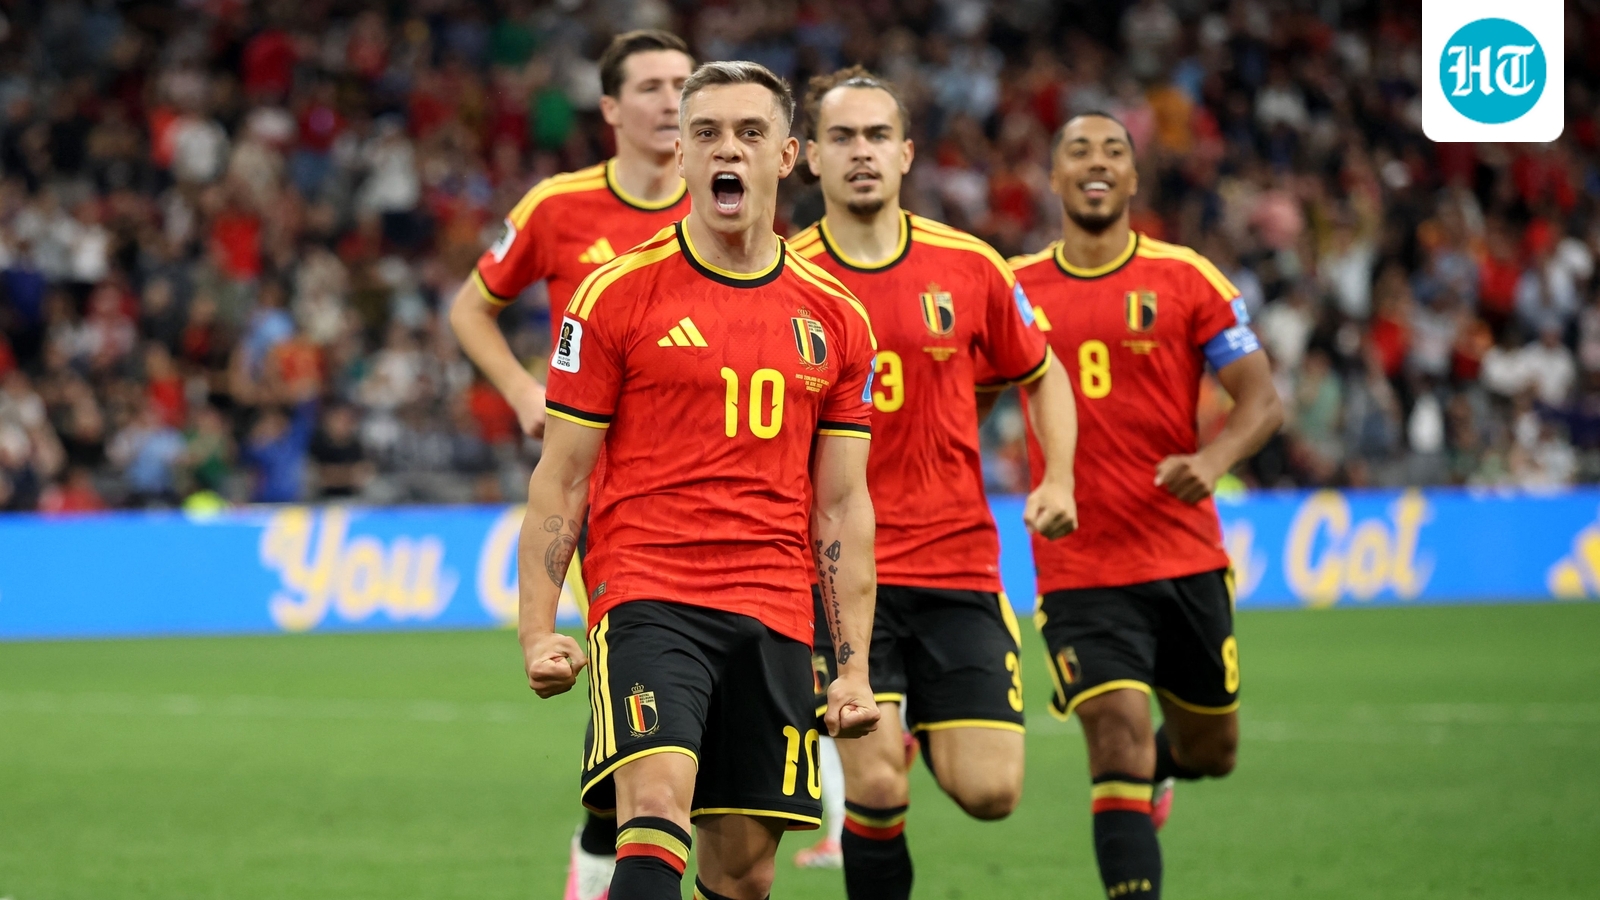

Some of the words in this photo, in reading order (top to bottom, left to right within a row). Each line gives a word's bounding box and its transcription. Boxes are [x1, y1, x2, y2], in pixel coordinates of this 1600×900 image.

[872, 350, 905, 413] 3
[1078, 339, 1112, 399] 8
[720, 366, 785, 440] 10
[260, 504, 459, 631] You
[1005, 652, 1024, 713] 3
[1221, 635, 1240, 694] 8
[782, 725, 822, 800] 10
